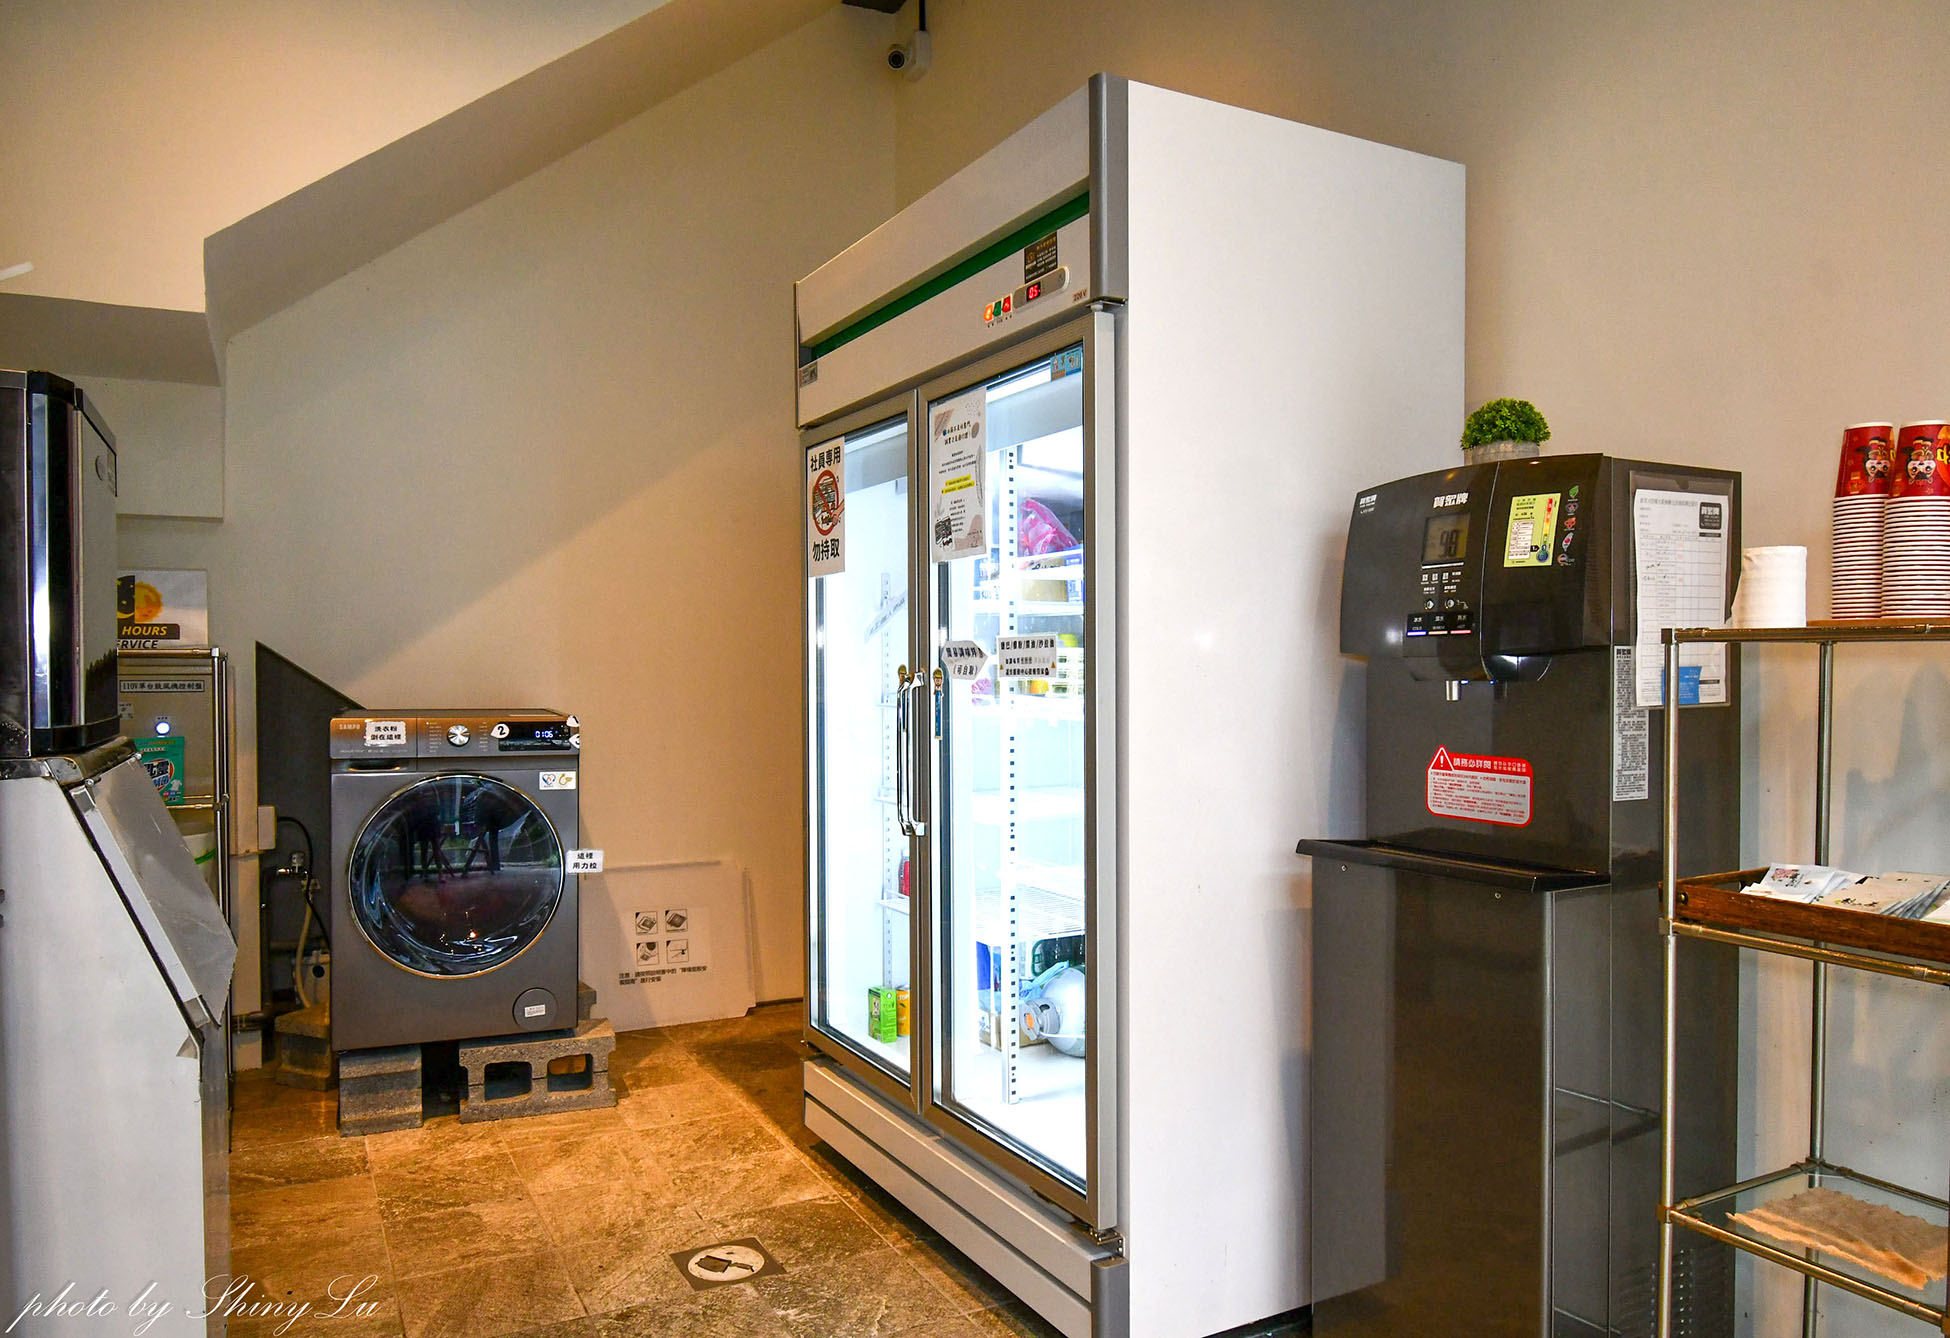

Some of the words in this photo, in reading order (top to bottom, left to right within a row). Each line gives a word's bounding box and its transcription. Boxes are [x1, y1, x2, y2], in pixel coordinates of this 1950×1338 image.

[812, 538, 840, 562] 勿持取
[122, 626, 168, 636] HOURS
[116, 640, 158, 649] RVICE
[497, 726, 506, 735] 2
